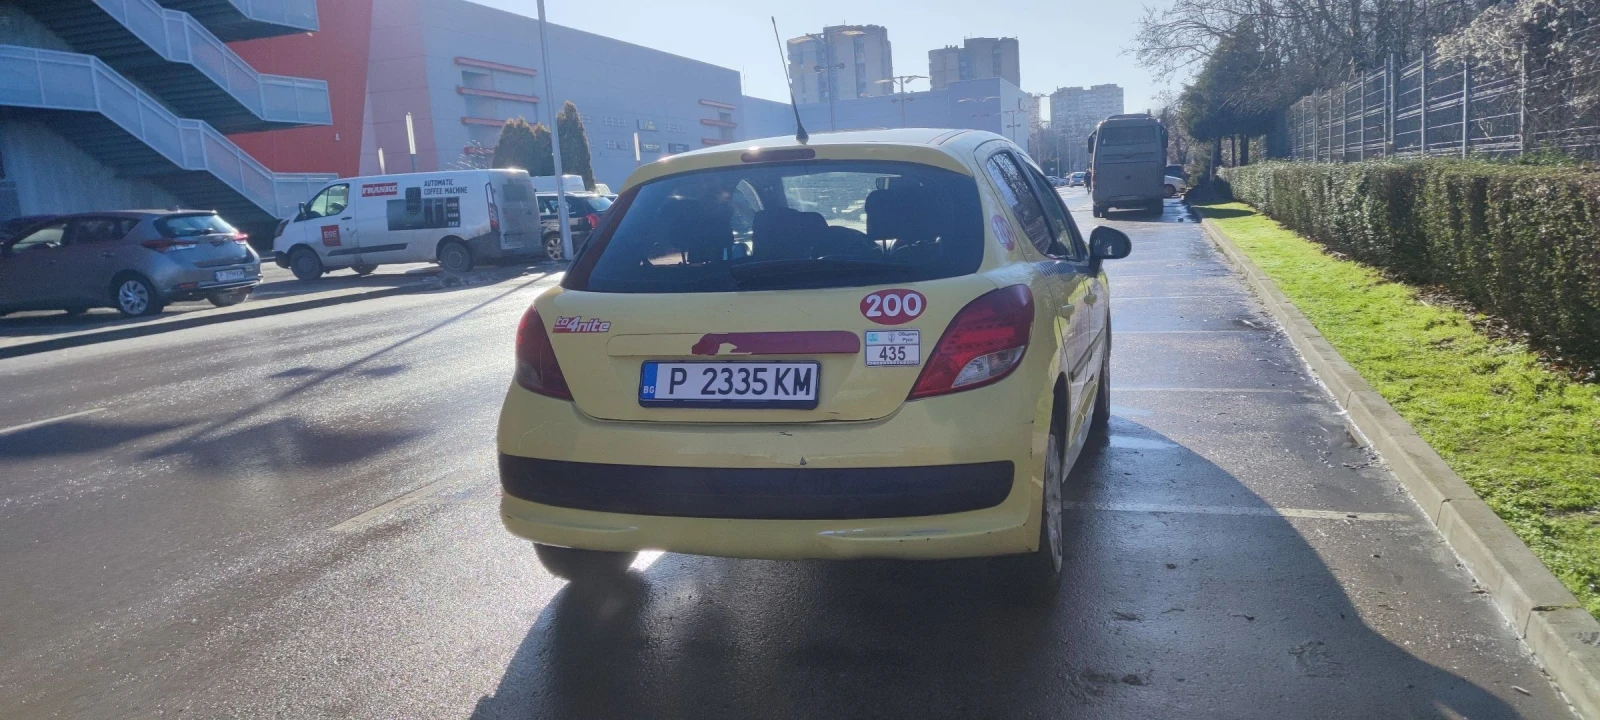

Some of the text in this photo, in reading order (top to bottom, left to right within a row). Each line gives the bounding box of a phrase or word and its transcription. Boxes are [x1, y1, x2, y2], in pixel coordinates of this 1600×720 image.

[424, 178, 454, 187] AUTOMATIC
[362, 185, 397, 195] FRANKE
[424, 186, 468, 196] COFFEE MACHINE
[866, 293, 922, 317] 200
[879, 346, 906, 361] 435
[668, 367, 688, 395] P
[643, 386, 655, 394] BG
